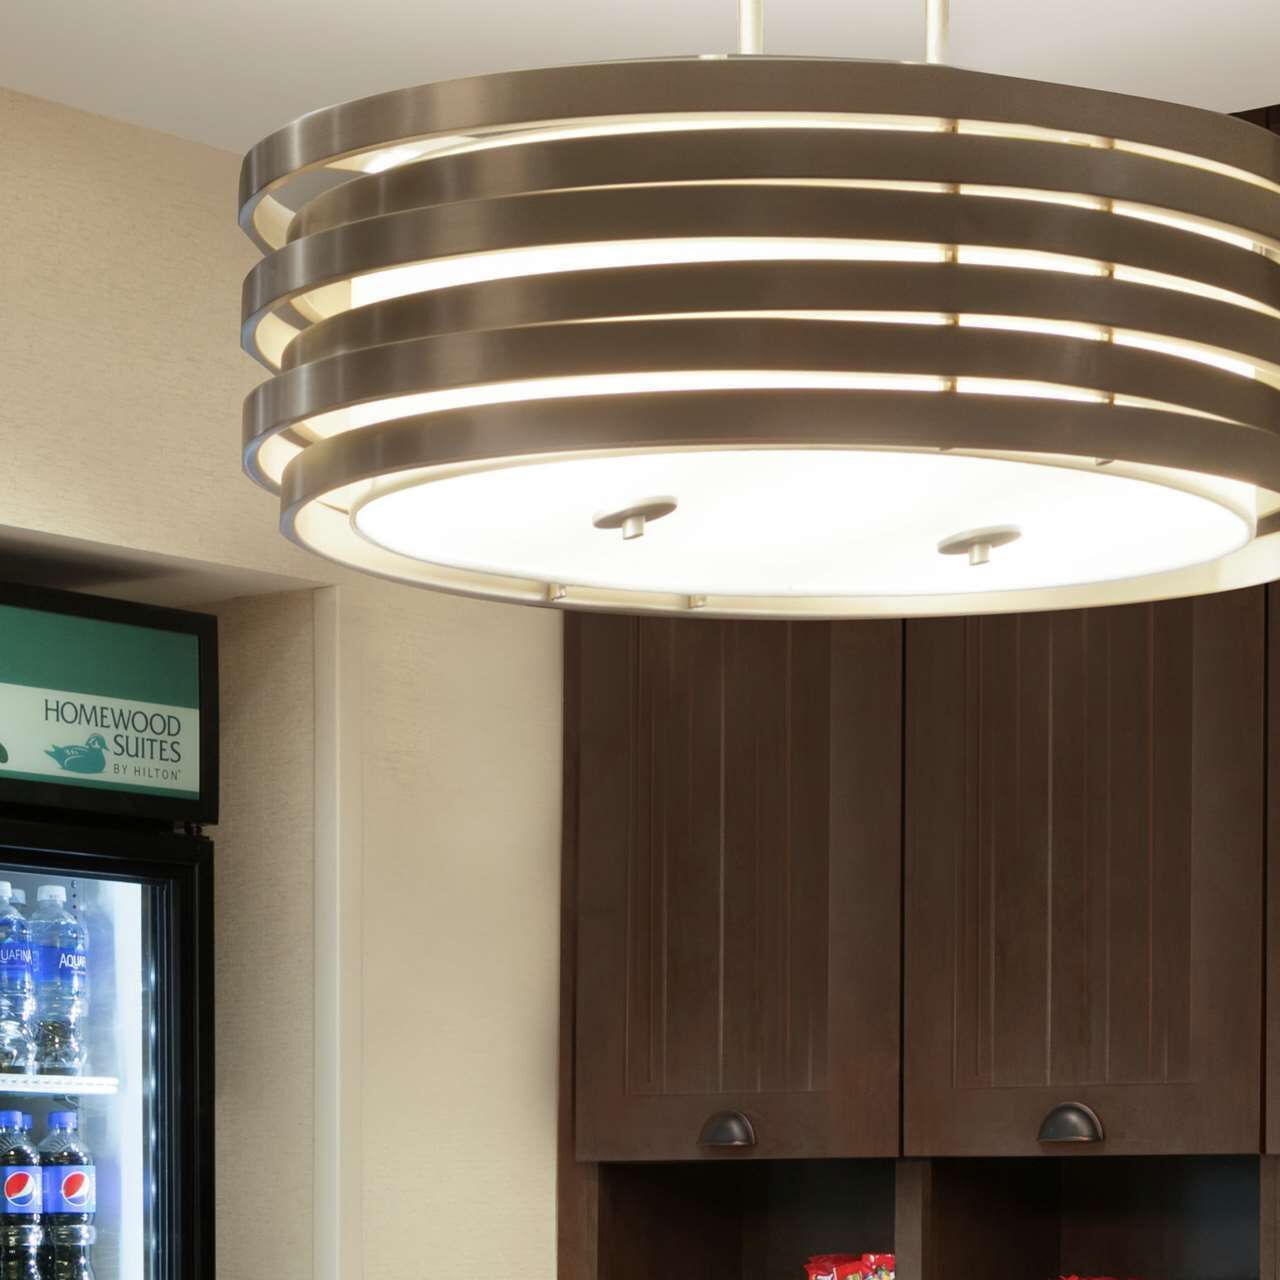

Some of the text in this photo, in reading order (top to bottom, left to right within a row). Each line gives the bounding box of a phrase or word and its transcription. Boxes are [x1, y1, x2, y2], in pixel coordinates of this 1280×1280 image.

[44, 699, 181, 737] HOMEWOOD
[113, 734, 182, 763] SUITES
[113, 764, 128, 775] BY
